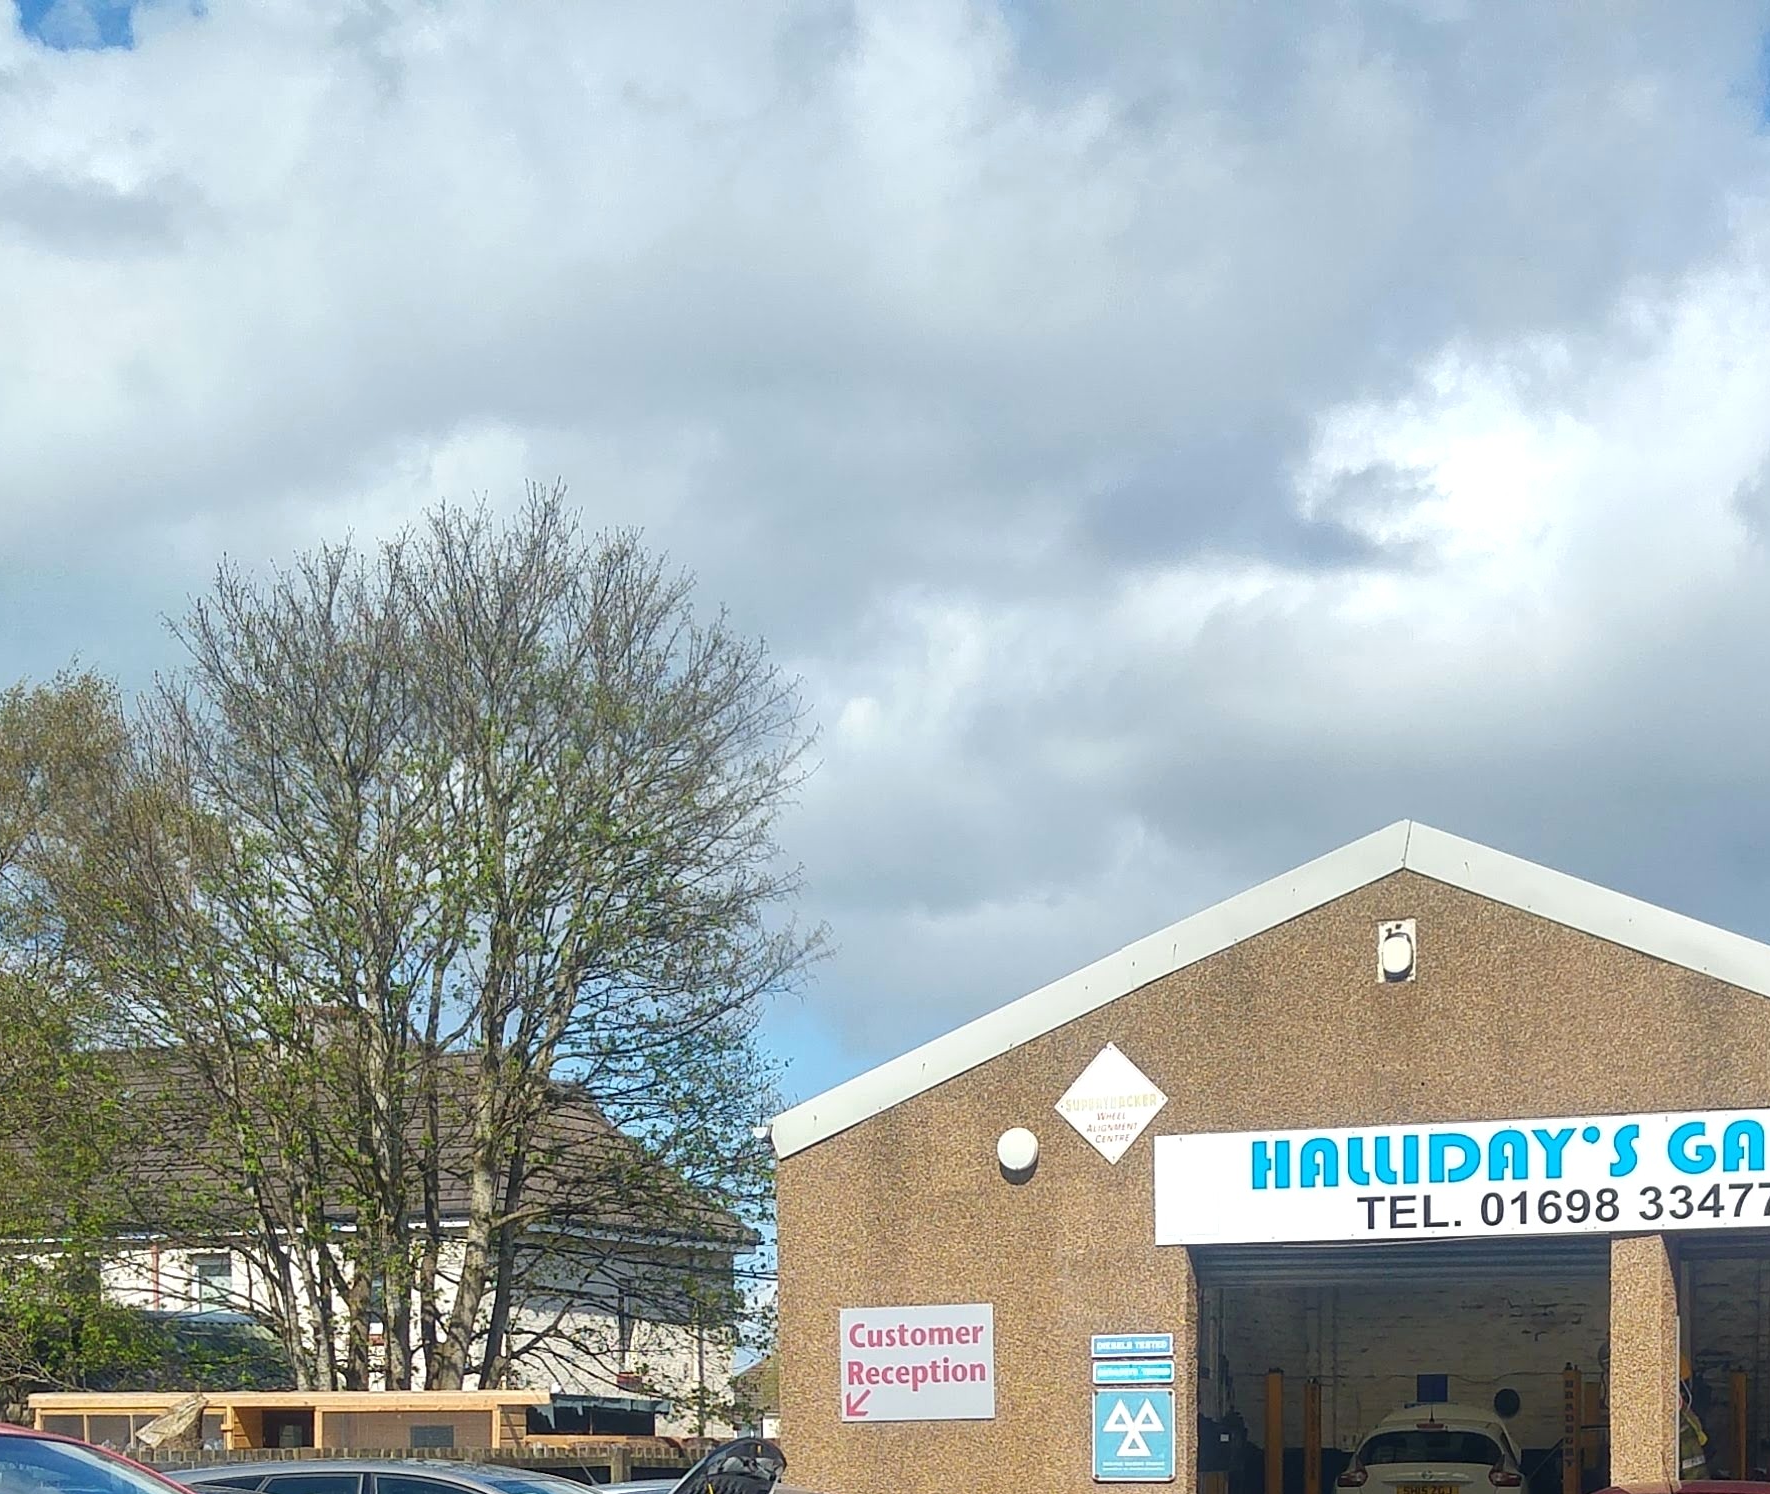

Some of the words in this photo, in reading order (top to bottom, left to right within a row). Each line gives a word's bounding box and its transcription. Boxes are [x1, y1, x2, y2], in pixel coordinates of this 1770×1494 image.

[1086, 1122, 1138, 1133] ALIGNMENT
[1096, 1111, 1127, 1121] WHEEL
[1095, 1133, 1131, 1144] CENTRE
[1252, 1124, 1640, 1190] HALLIDAY'S
[1357, 1194, 1462, 1230] TEL.
[1480, 1187, 1620, 1226] 01698
[849, 1323, 984, 1348] Customer
[848, 1357, 986, 1391] Reception
